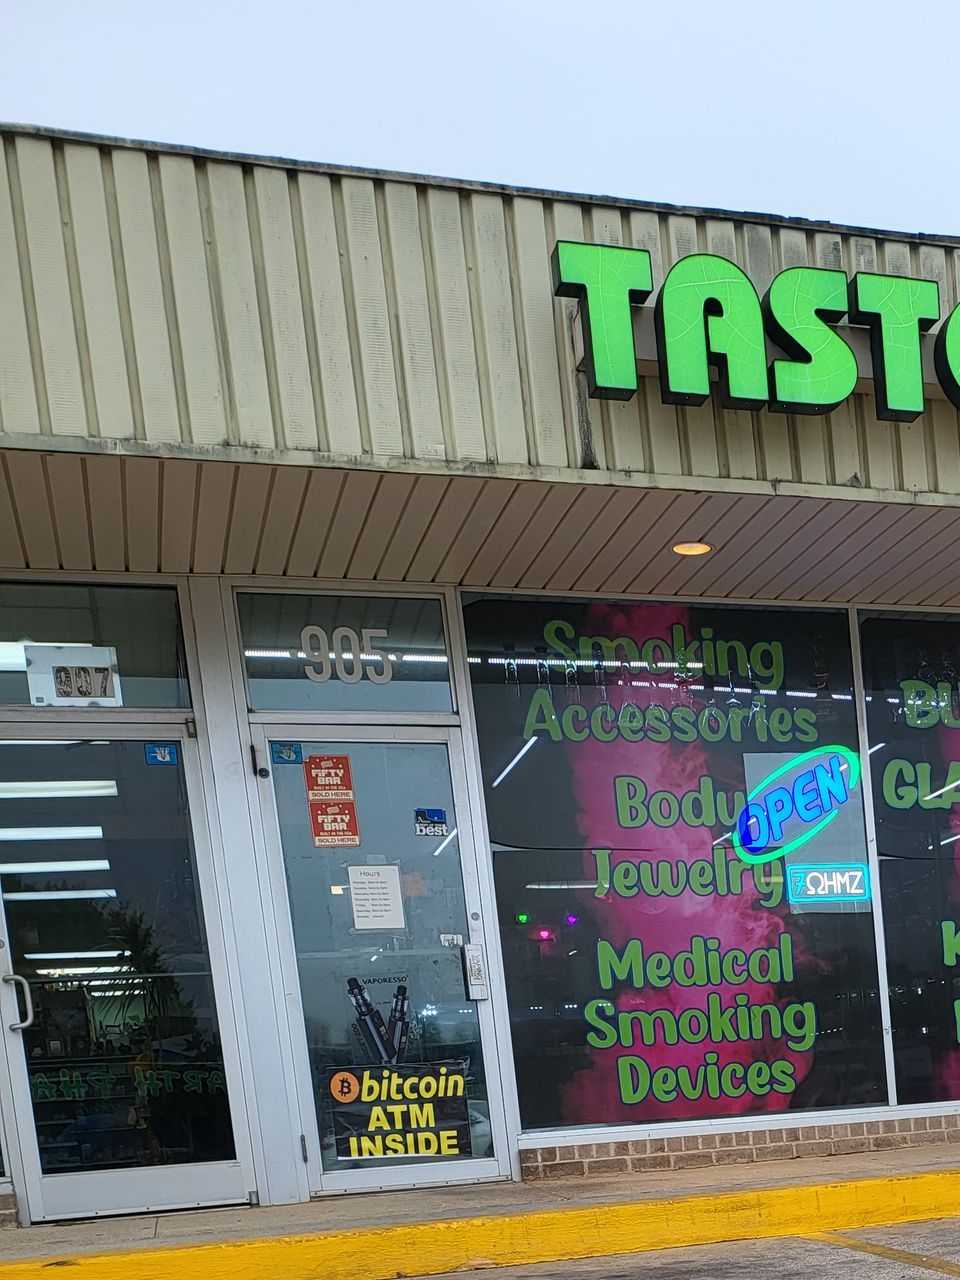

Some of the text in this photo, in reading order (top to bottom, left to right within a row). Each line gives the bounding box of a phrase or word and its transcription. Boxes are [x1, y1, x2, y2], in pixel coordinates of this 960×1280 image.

[300, 625, 393, 685] 905
[543, 619, 785, 691] Smoking
[55, 666, 110, 696] 907
[522, 688, 819, 743] Accessories
[317, 776, 341, 785] BAR
[613, 775, 748, 830] Body
[738, 754, 848, 853] OPEN
[323, 822, 347, 831] BAR
[415, 824, 448, 836] best
[591, 846, 785, 907] Jewelry
[362, 976, 407, 985] VAPORESSO
[596, 933, 795, 990] Medical
[583, 994, 817, 1052] Smoking
[360, 1066, 464, 1102] bitcoin
[617, 1055, 797, 1105] Devices
[367, 1103, 436, 1132] ATM
[349, 1130, 460, 1158] INSIDE
